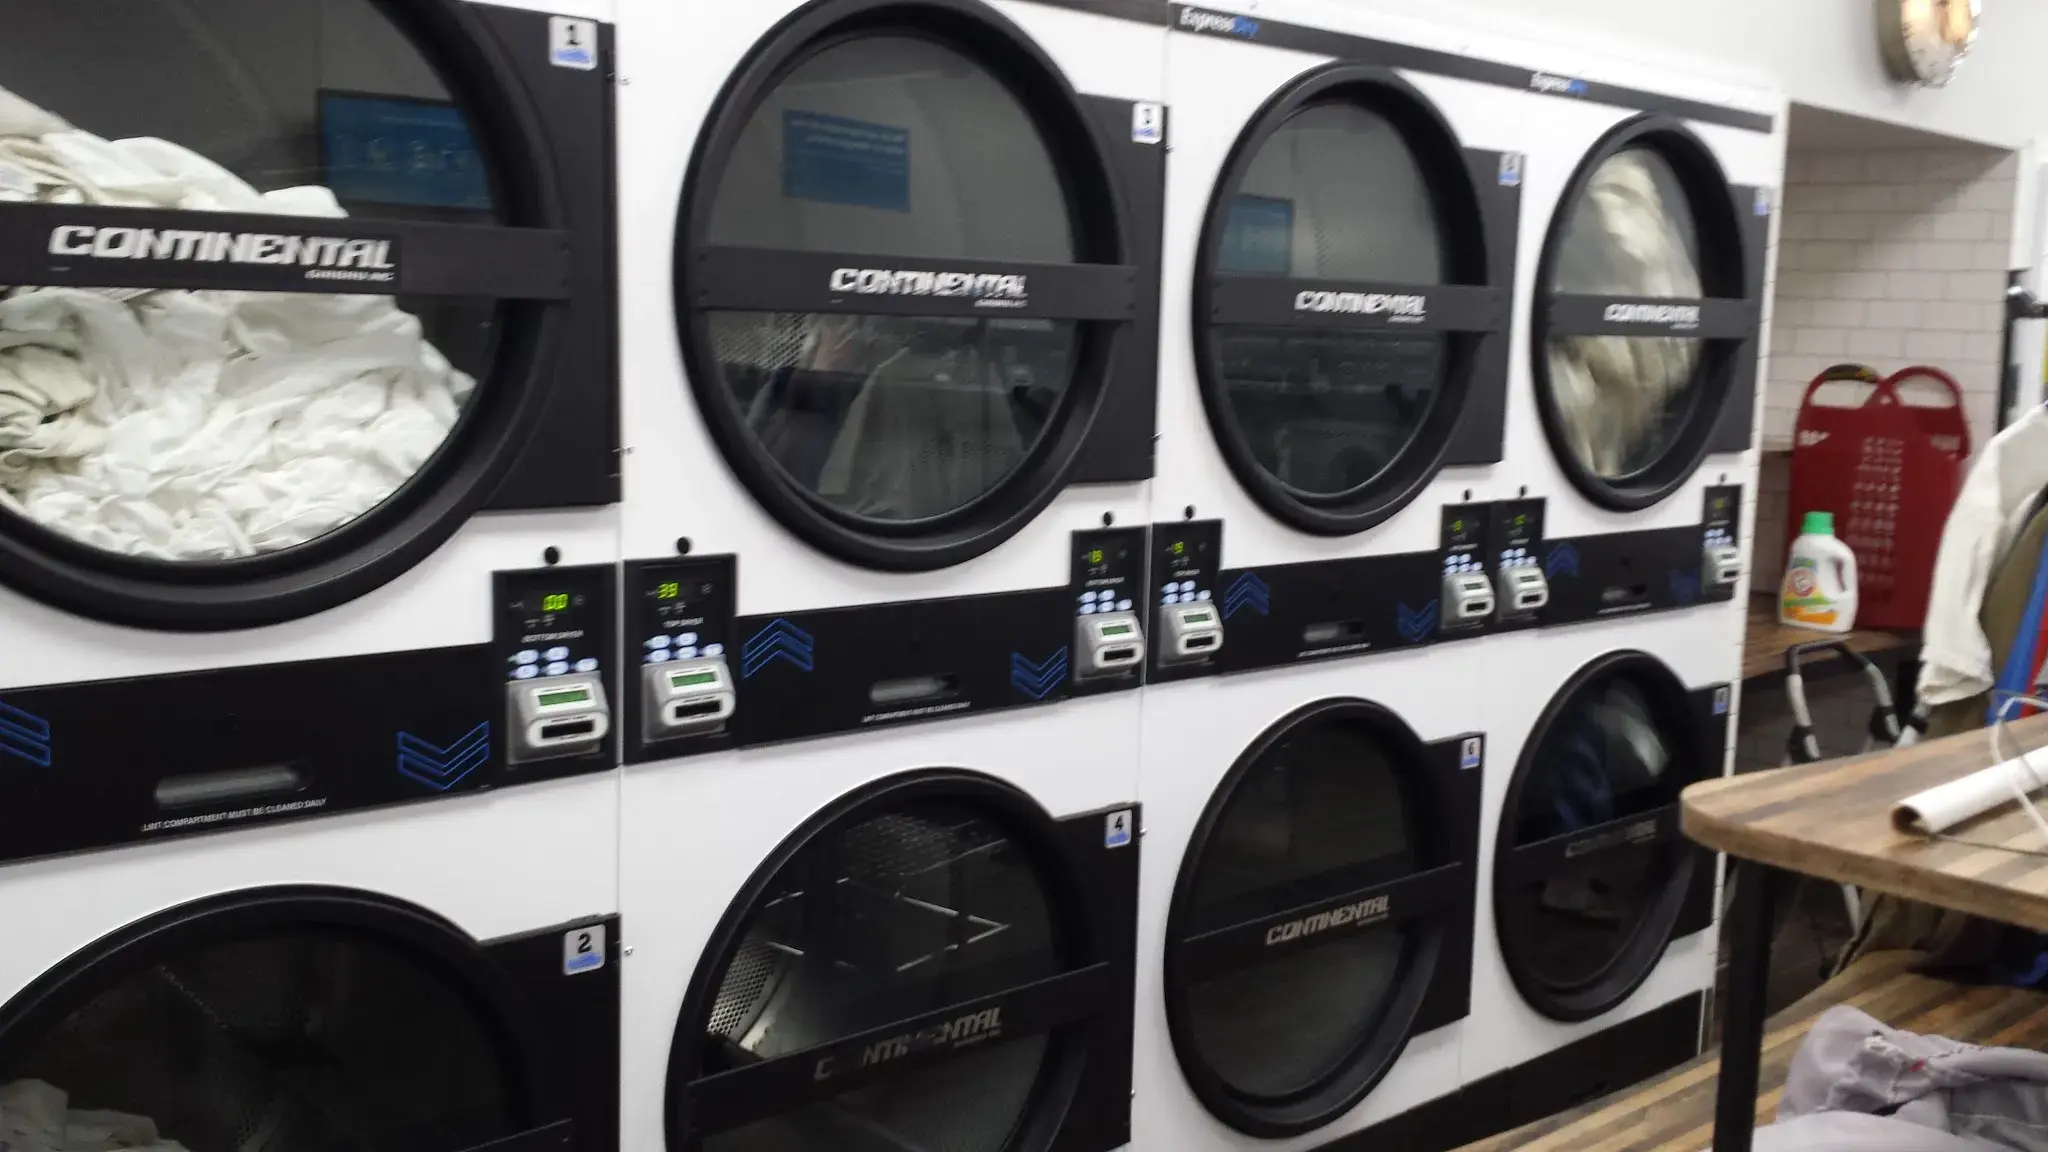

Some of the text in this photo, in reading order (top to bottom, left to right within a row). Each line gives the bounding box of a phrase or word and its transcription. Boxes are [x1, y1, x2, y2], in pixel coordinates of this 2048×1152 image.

[565, 23, 582, 47] 1
[49, 225, 395, 268] CONTINENTAL
[828, 267, 1029, 298] CONTINENTAL
[1294, 290, 1427, 316] CONTINENTAL
[163, 812, 227, 829] COMPARTMENT
[228, 808, 251, 819] MUST
[252, 806, 265, 816] BE
[266, 801, 304, 813] CLEANED
[304, 797, 327, 808] DAILY
[1114, 814, 1125, 832] 4
[1265, 894, 1390, 945] CONTINENTAL
[577, 932, 593, 954] 2
